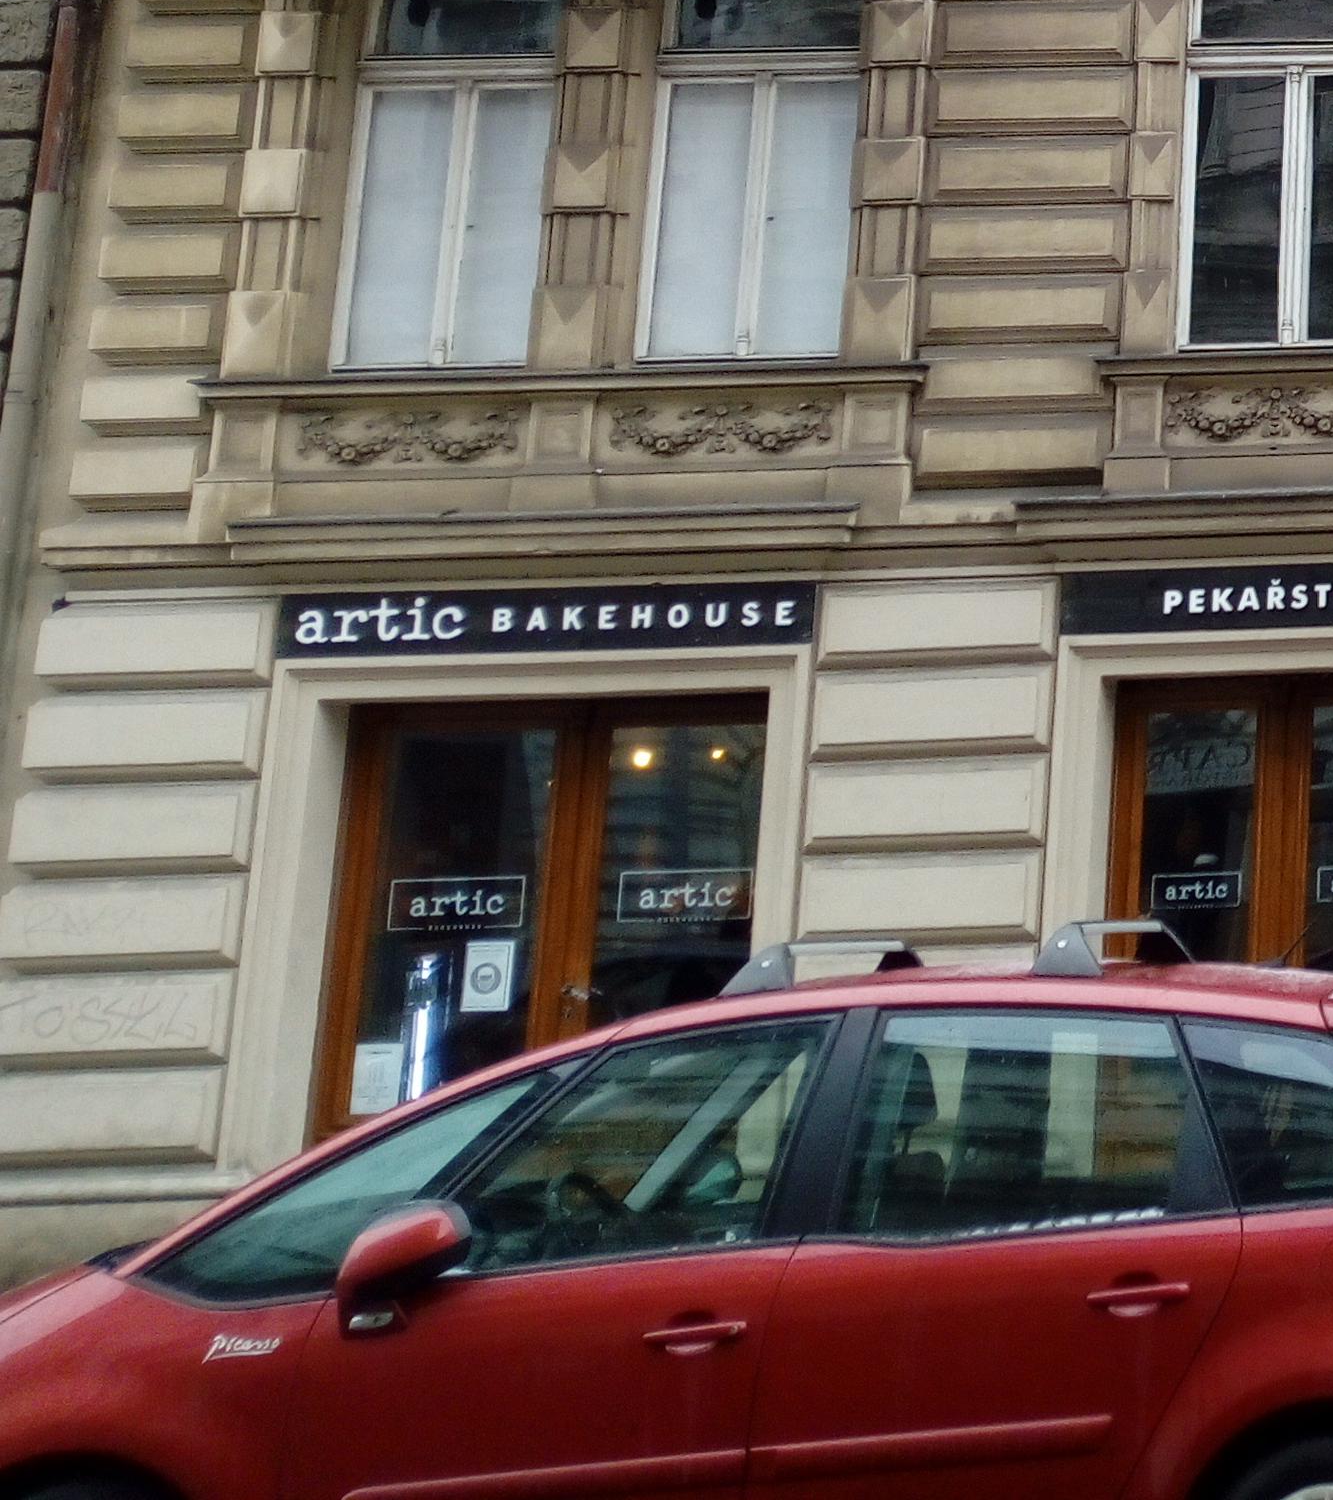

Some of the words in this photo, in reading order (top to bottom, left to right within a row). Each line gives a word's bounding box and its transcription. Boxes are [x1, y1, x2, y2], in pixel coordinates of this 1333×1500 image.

[294, 597, 466, 645] artic
[491, 600, 797, 634] BAKEHOUSE
[409, 889, 506, 918] artic
[638, 881, 737, 910] artic
[1165, 879, 1229, 901] artic
